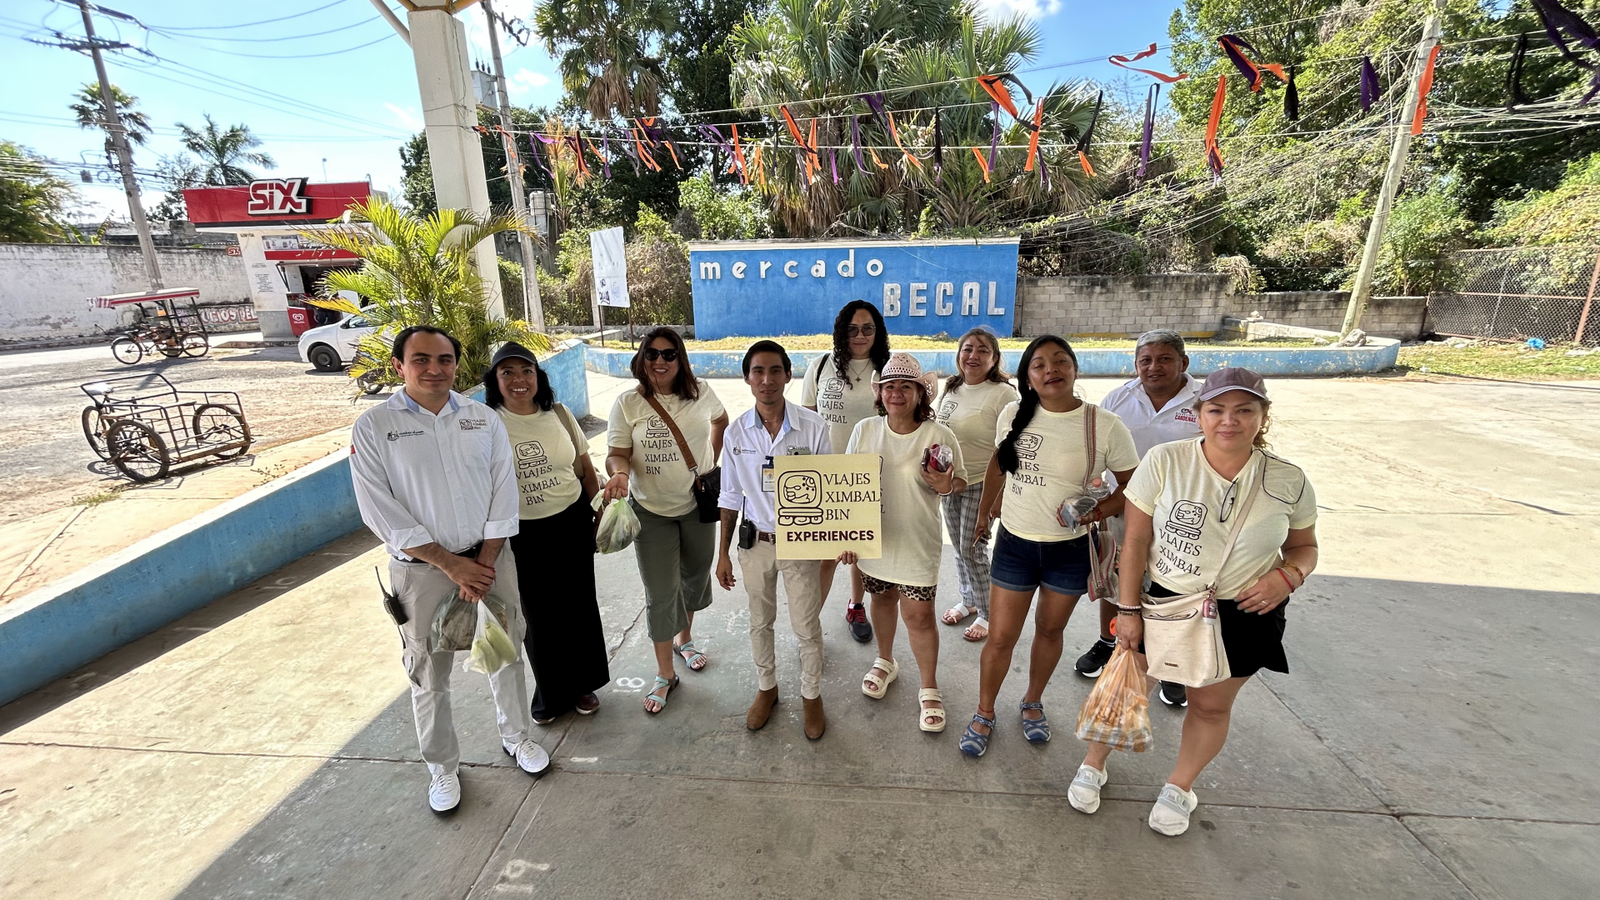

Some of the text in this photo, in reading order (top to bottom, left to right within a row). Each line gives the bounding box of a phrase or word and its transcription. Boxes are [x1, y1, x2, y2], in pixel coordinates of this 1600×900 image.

[700, 249, 884, 280] mercado
[883, 281, 1005, 317] BECAL
[640, 439, 673, 450] VIAJES
[645, 453, 680, 463] XIMBAL
[515, 464, 553, 480] VIAJES
[646, 466, 661, 475] BIN
[521, 477, 561, 493] XIMBAL
[823, 472, 871, 487] VIAJES
[525, 494, 545, 506] BIN
[825, 490, 880, 503] XIMBAL
[825, 508, 850, 520] BIN
[786, 530, 875, 542] EXPERIENCES
[1159, 528, 1203, 557] VIAJES
[1155, 558, 1172, 576] BIN
[1159, 545, 1202, 577] XIMBAL
